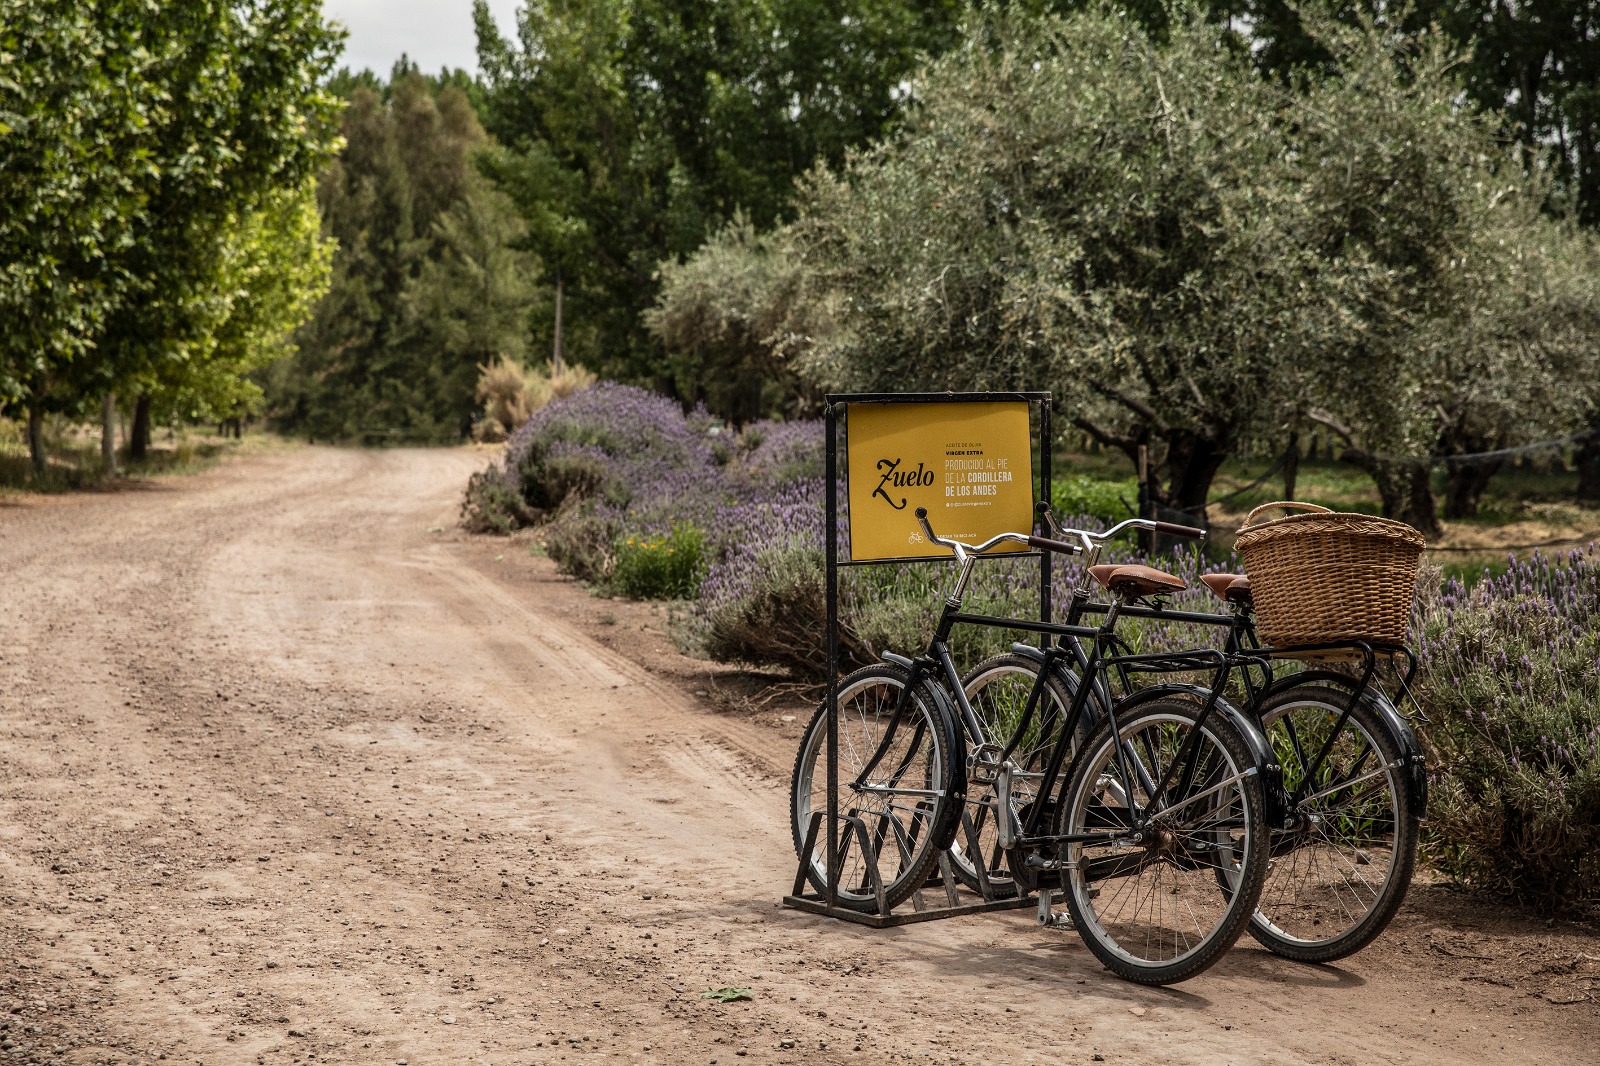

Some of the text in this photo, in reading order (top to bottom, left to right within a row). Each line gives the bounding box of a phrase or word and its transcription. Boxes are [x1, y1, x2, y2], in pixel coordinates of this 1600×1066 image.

[946, 458, 1008, 470] PRODUCIDO AL PIE
[872, 458, 935, 510] Zuelo
[945, 472, 1012, 484] DE LA CORDILLERA
[946, 485, 997, 496] DE LOS ANDES
